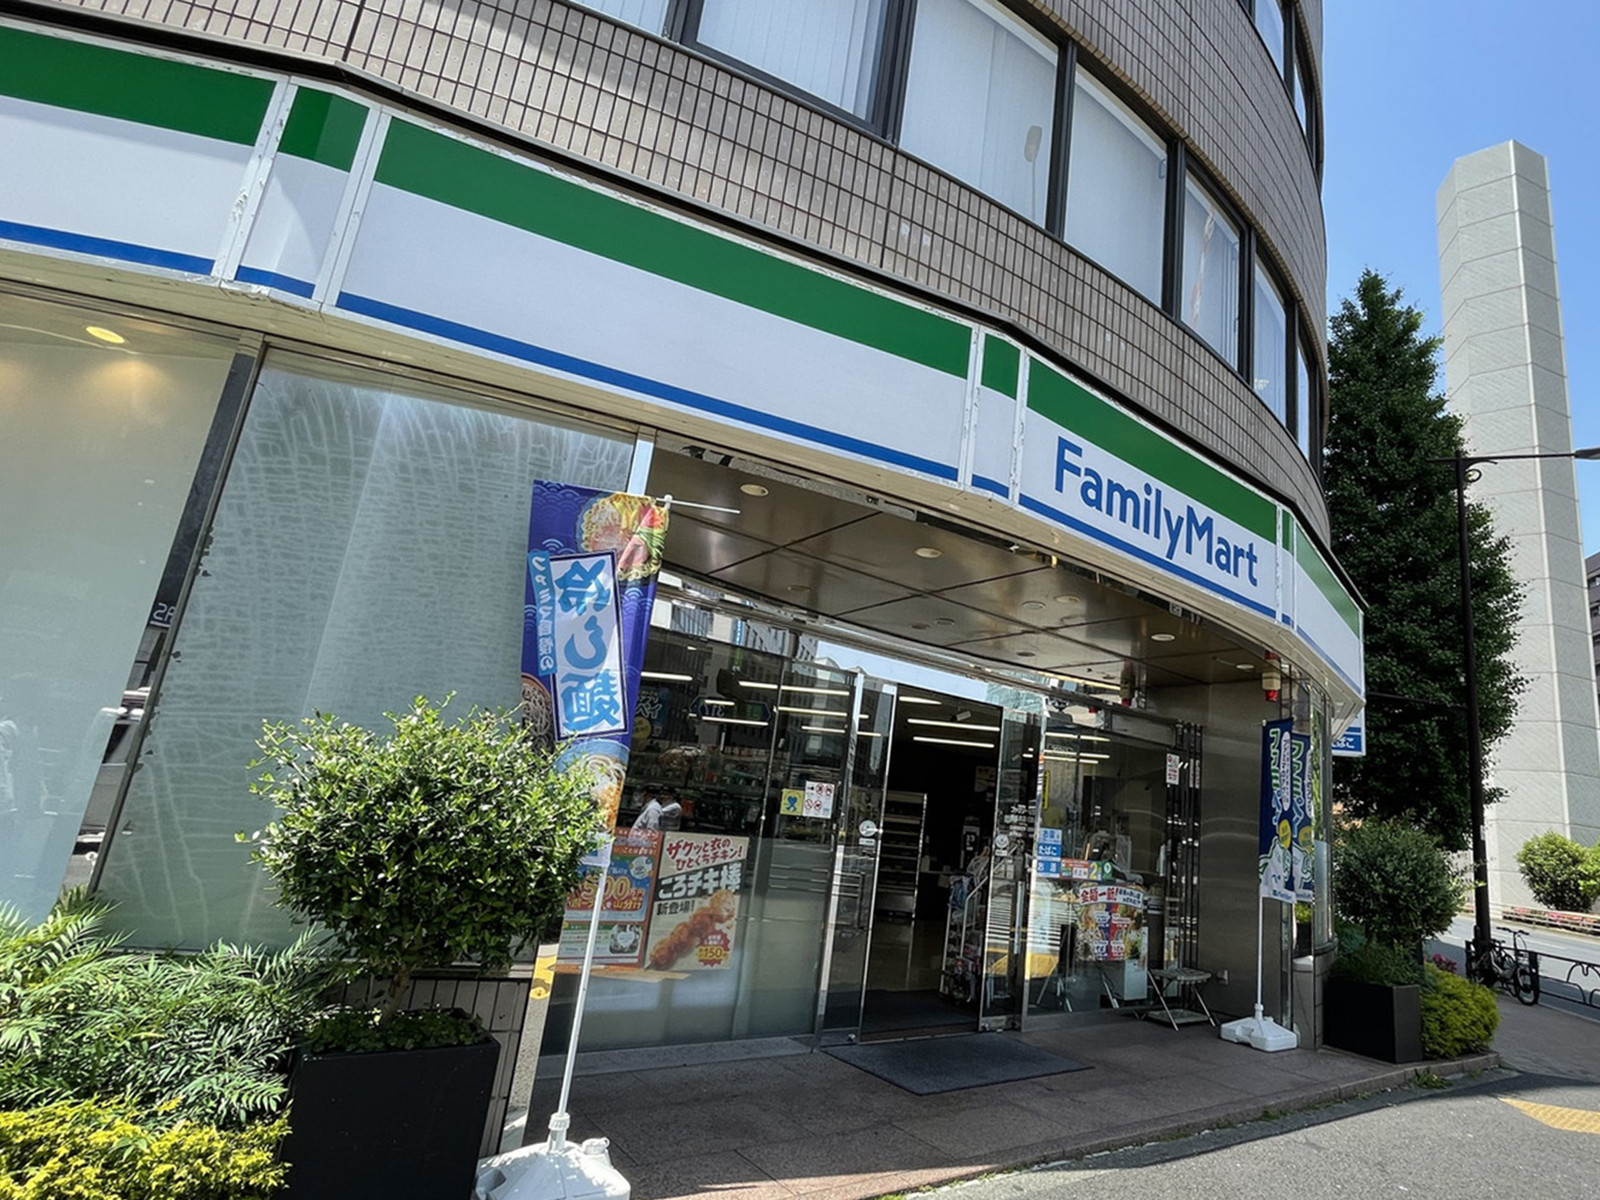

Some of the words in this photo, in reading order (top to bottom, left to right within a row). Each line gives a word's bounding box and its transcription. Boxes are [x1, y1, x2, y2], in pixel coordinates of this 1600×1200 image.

[1055, 436, 1257, 587] FamilyMart
[666, 837, 731, 859] ザクッと衣の
[658, 861, 741, 899] ころチキ棒
[656, 900, 694, 916] 新登場!
